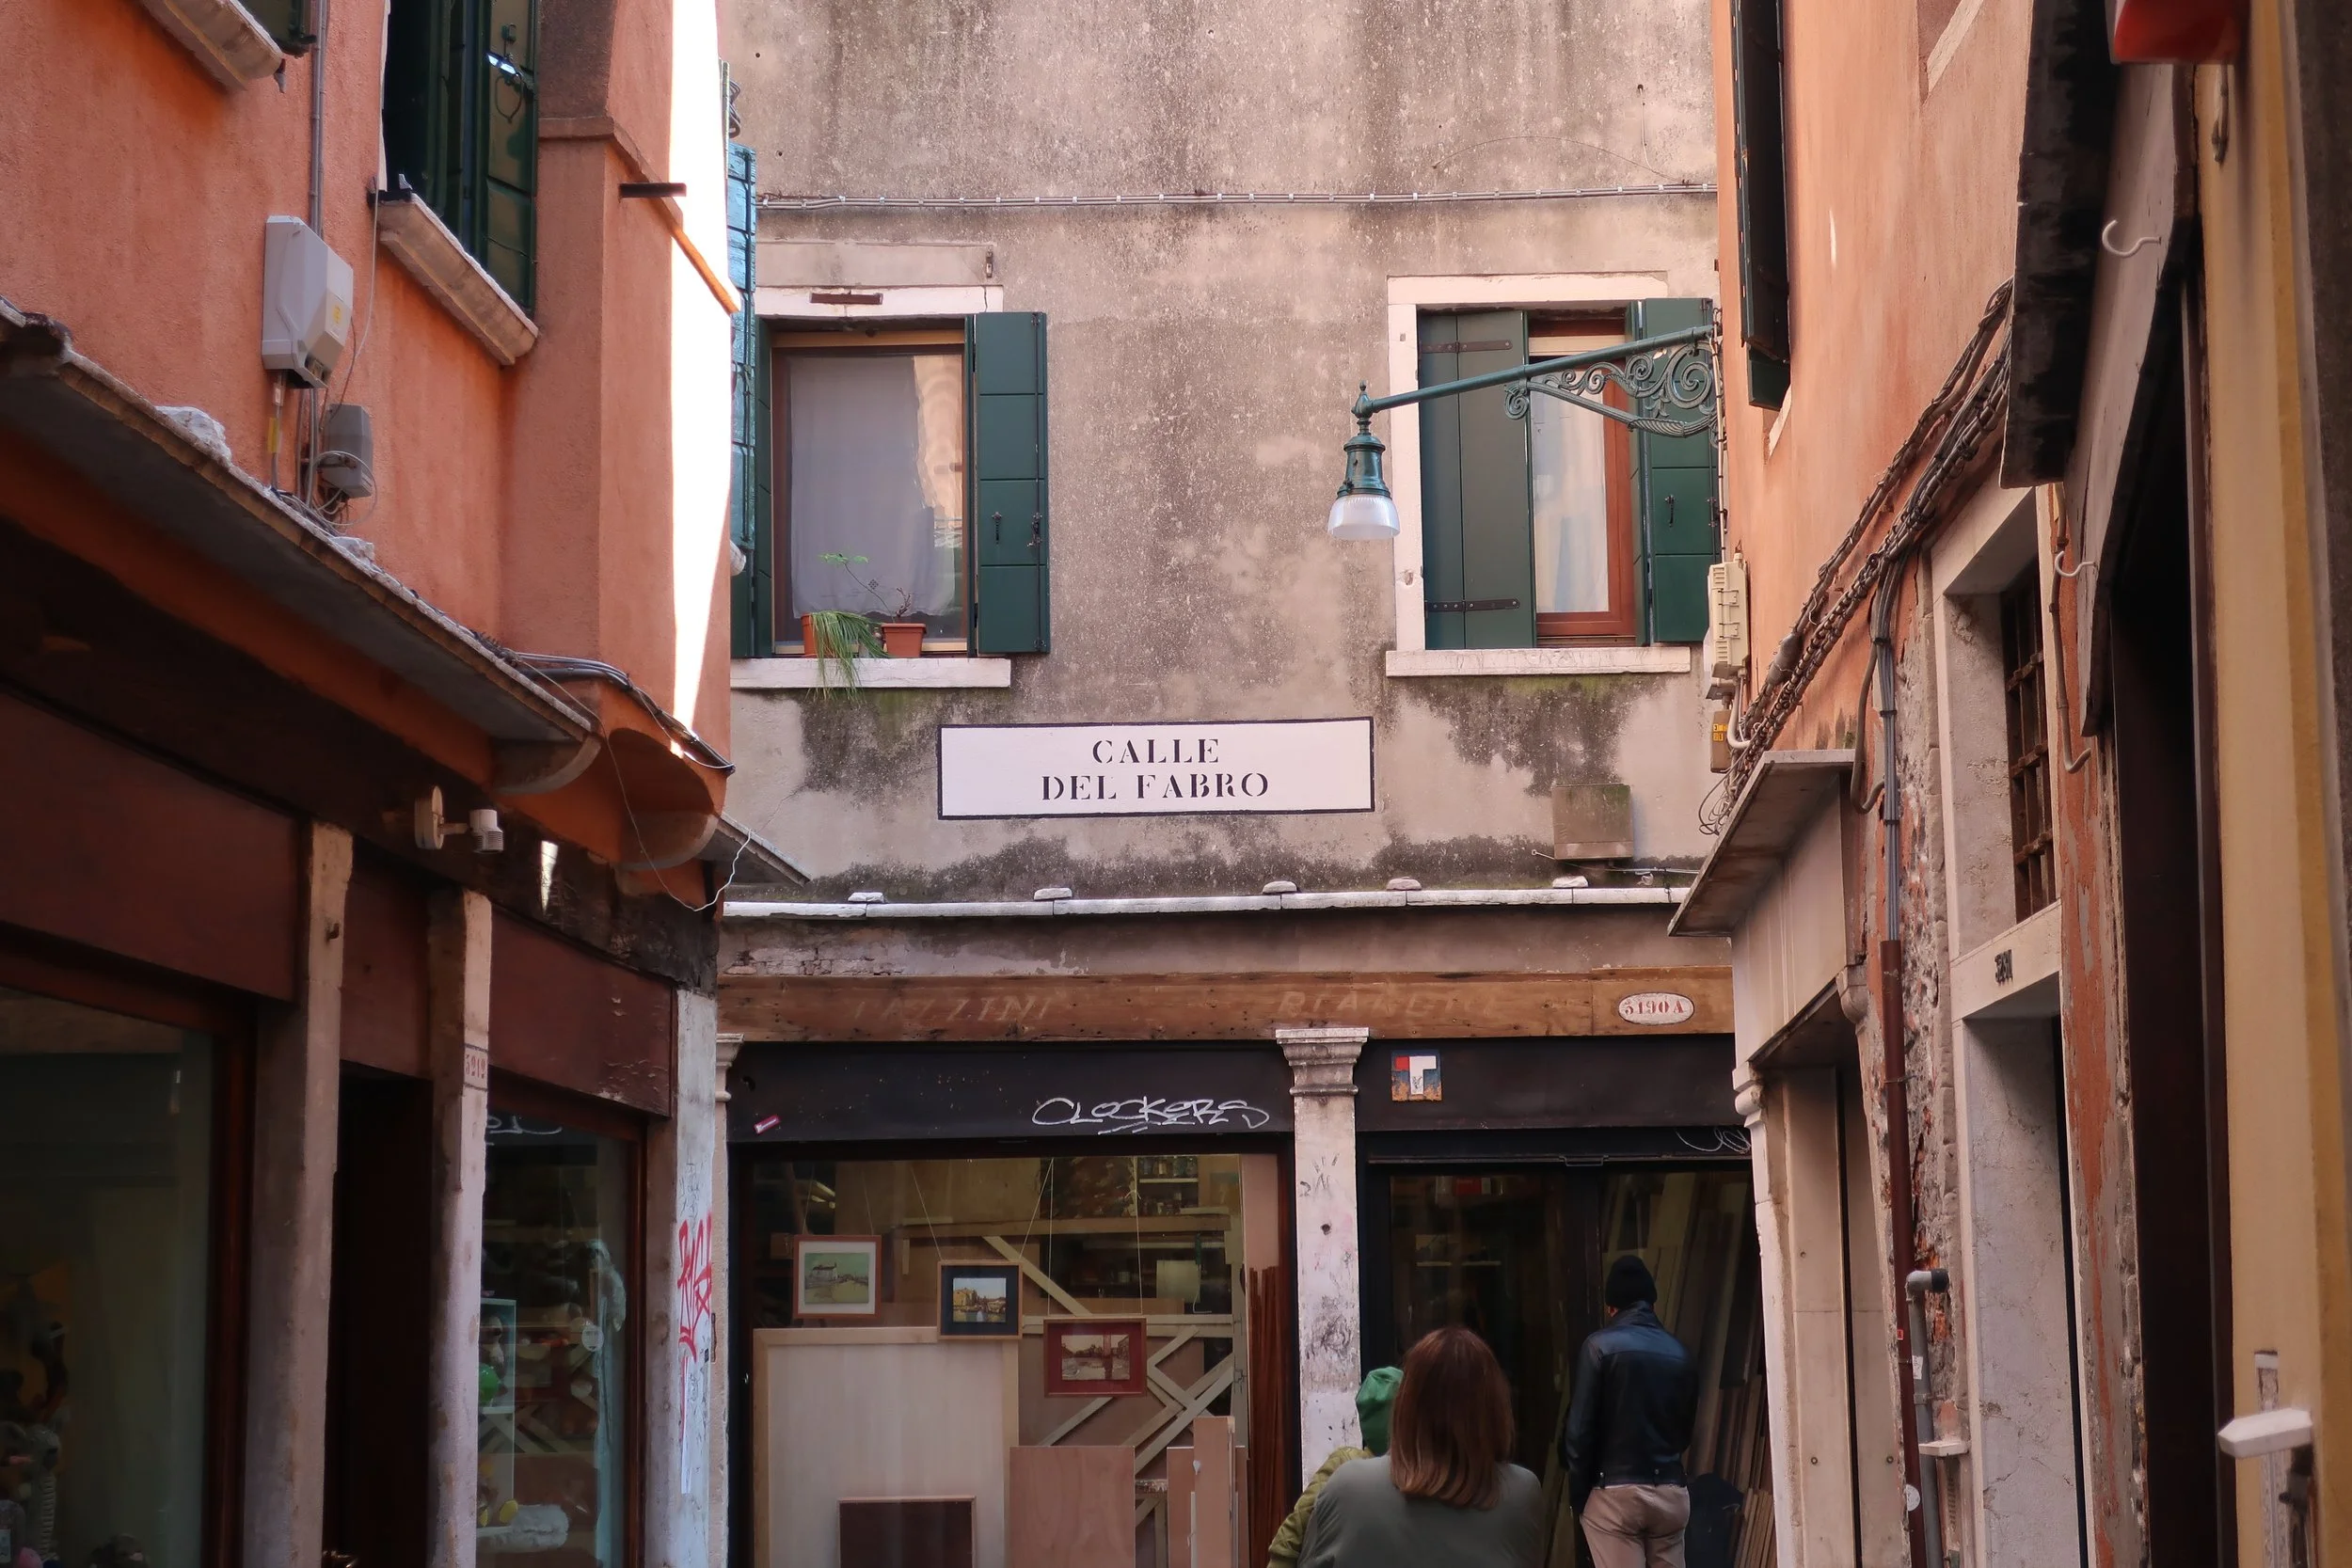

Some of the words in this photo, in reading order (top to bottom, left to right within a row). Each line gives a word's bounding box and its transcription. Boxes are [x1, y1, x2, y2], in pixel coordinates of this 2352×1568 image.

[1092, 738, 1219, 764] CALLE
[1041, 775, 1117, 800] DEL
[1136, 772, 1269, 800] FABRO
[1032, 1096, 1270, 1130] CLOCKERS
